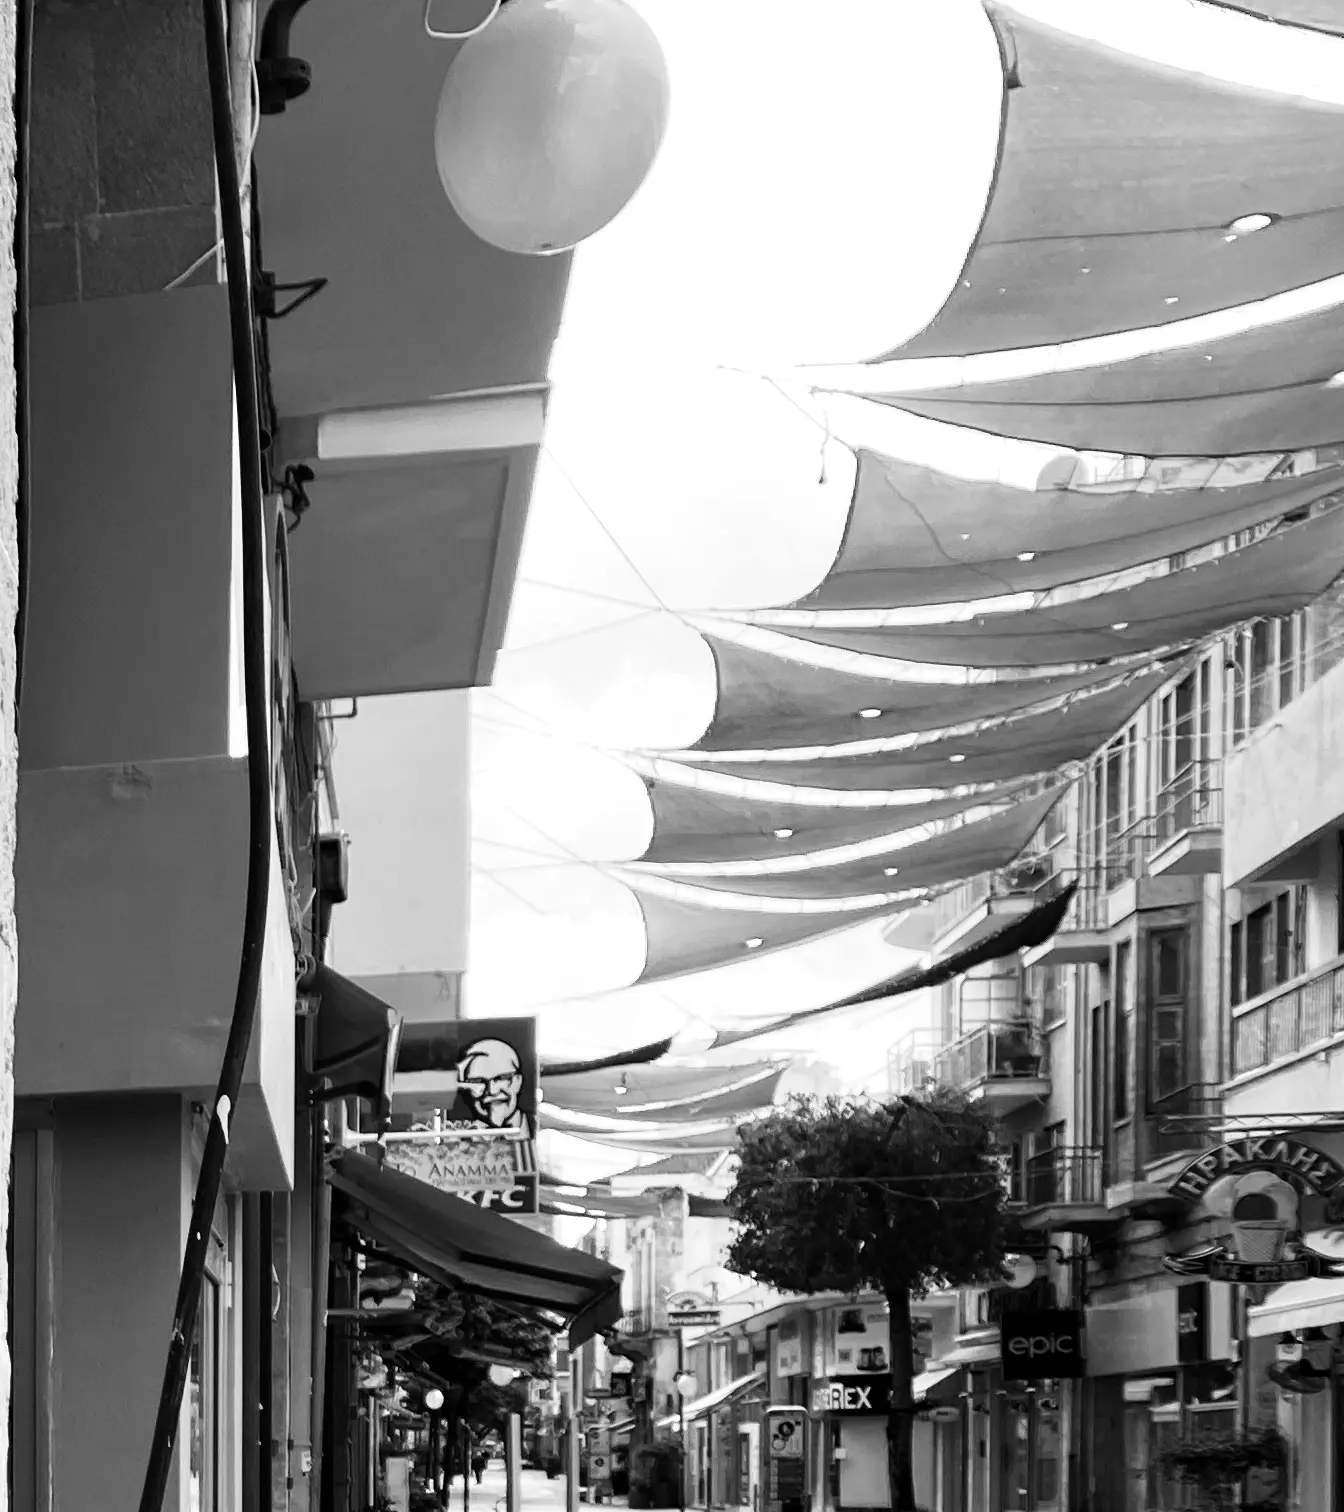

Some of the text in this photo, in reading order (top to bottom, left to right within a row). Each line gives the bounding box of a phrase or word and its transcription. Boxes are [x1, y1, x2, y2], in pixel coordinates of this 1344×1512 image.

[1178, 1137, 1339, 1196] ΗΡΑΚΛΗΣ
[457, 1185, 526, 1209] KFC
[1008, 1332, 1074, 1359] epic
